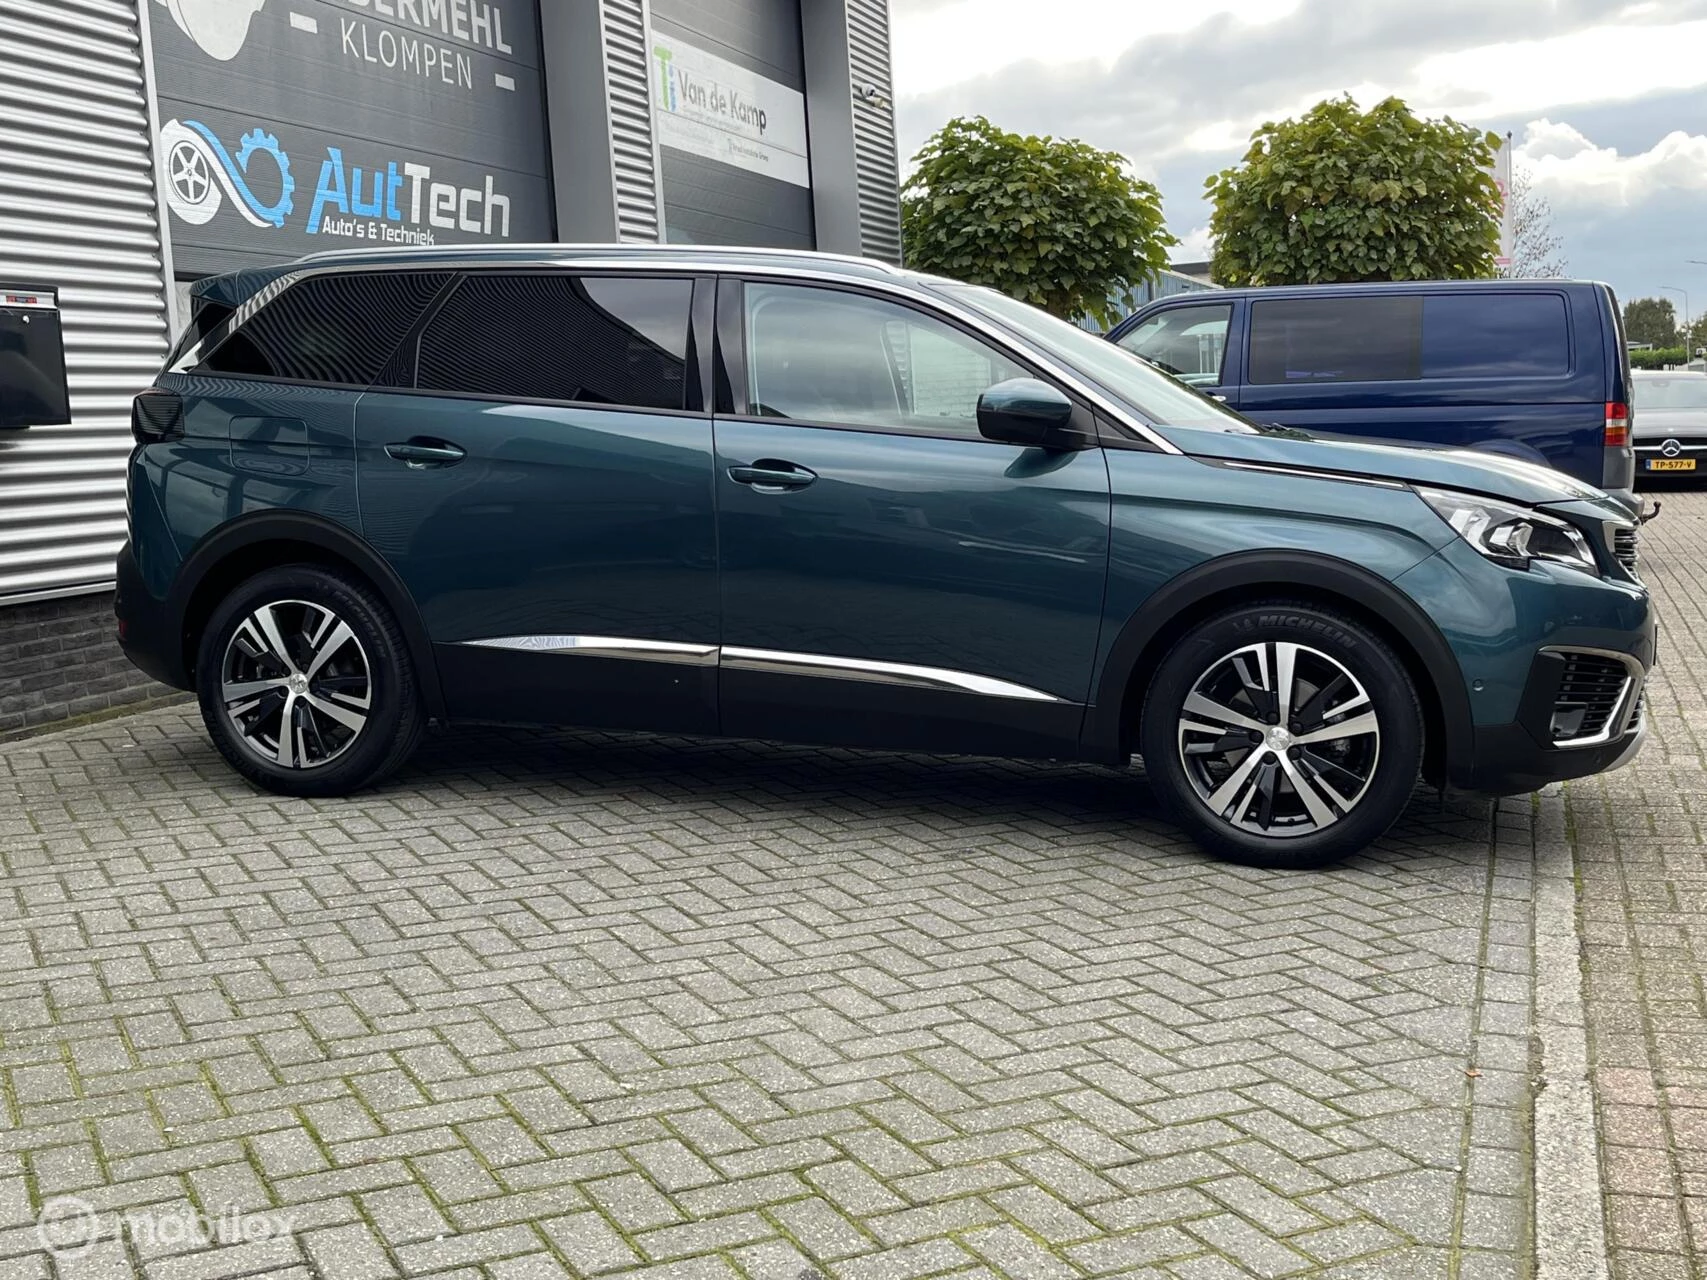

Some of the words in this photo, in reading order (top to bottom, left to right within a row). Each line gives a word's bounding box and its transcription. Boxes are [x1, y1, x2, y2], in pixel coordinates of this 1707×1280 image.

[341, 18, 472, 89] KLOMPEN
[678, 70, 706, 109] Van
[710, 83, 726, 114] de
[730, 89, 767, 135] Kamp
[306, 147, 510, 237] AutTech
[323, 216, 364, 238] Auto's
[368, 222, 377, 240] &
[381, 223, 434, 246] Techniek
[1258, 615, 1357, 648] MICHELIN
